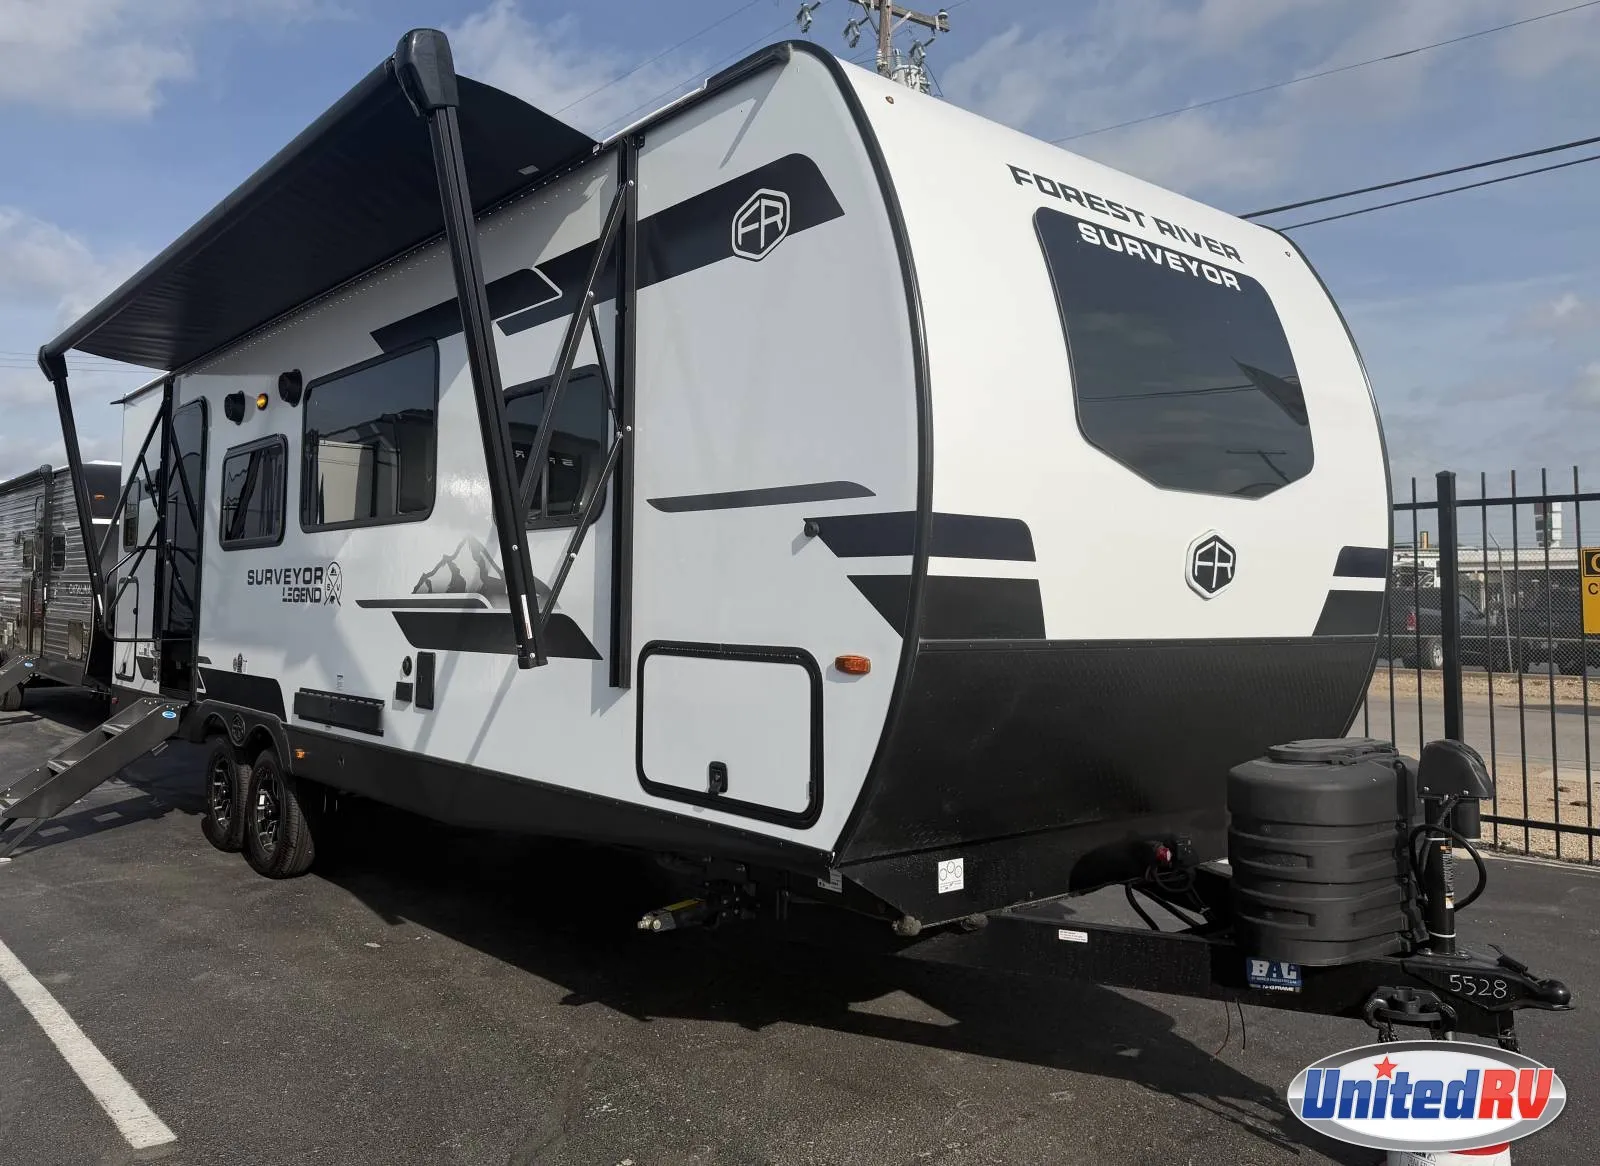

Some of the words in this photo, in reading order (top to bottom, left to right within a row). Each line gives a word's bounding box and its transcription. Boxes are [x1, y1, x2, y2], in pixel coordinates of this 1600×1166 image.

[1006, 164, 1146, 228] FOREST
[1152, 216, 1245, 264] RIVER
[1078, 222, 1241, 291] SURVEYOR
[247, 567, 324, 585] SURVEYOR
[282, 587, 322, 603] LEGEND
[1449, 974, 1507, 999] 5528
